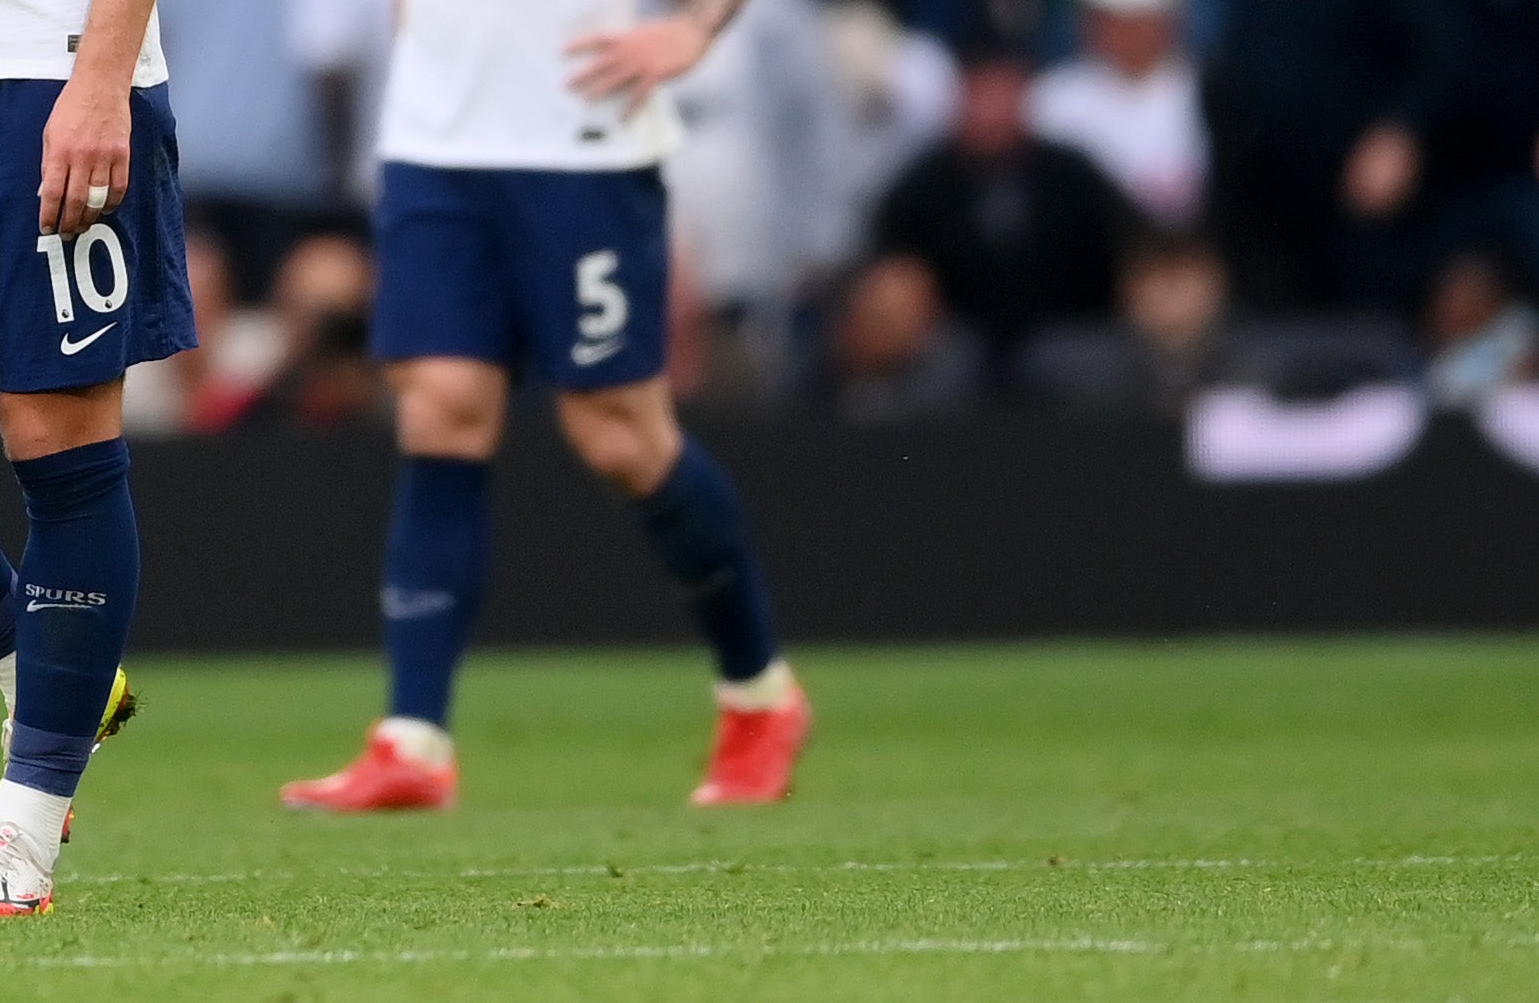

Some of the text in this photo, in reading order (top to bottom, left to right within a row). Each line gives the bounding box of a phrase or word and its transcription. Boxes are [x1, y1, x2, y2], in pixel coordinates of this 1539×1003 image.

[36, 223, 128, 324] 10
[575, 249, 628, 338] 5
[25, 583, 107, 606] SPURS
